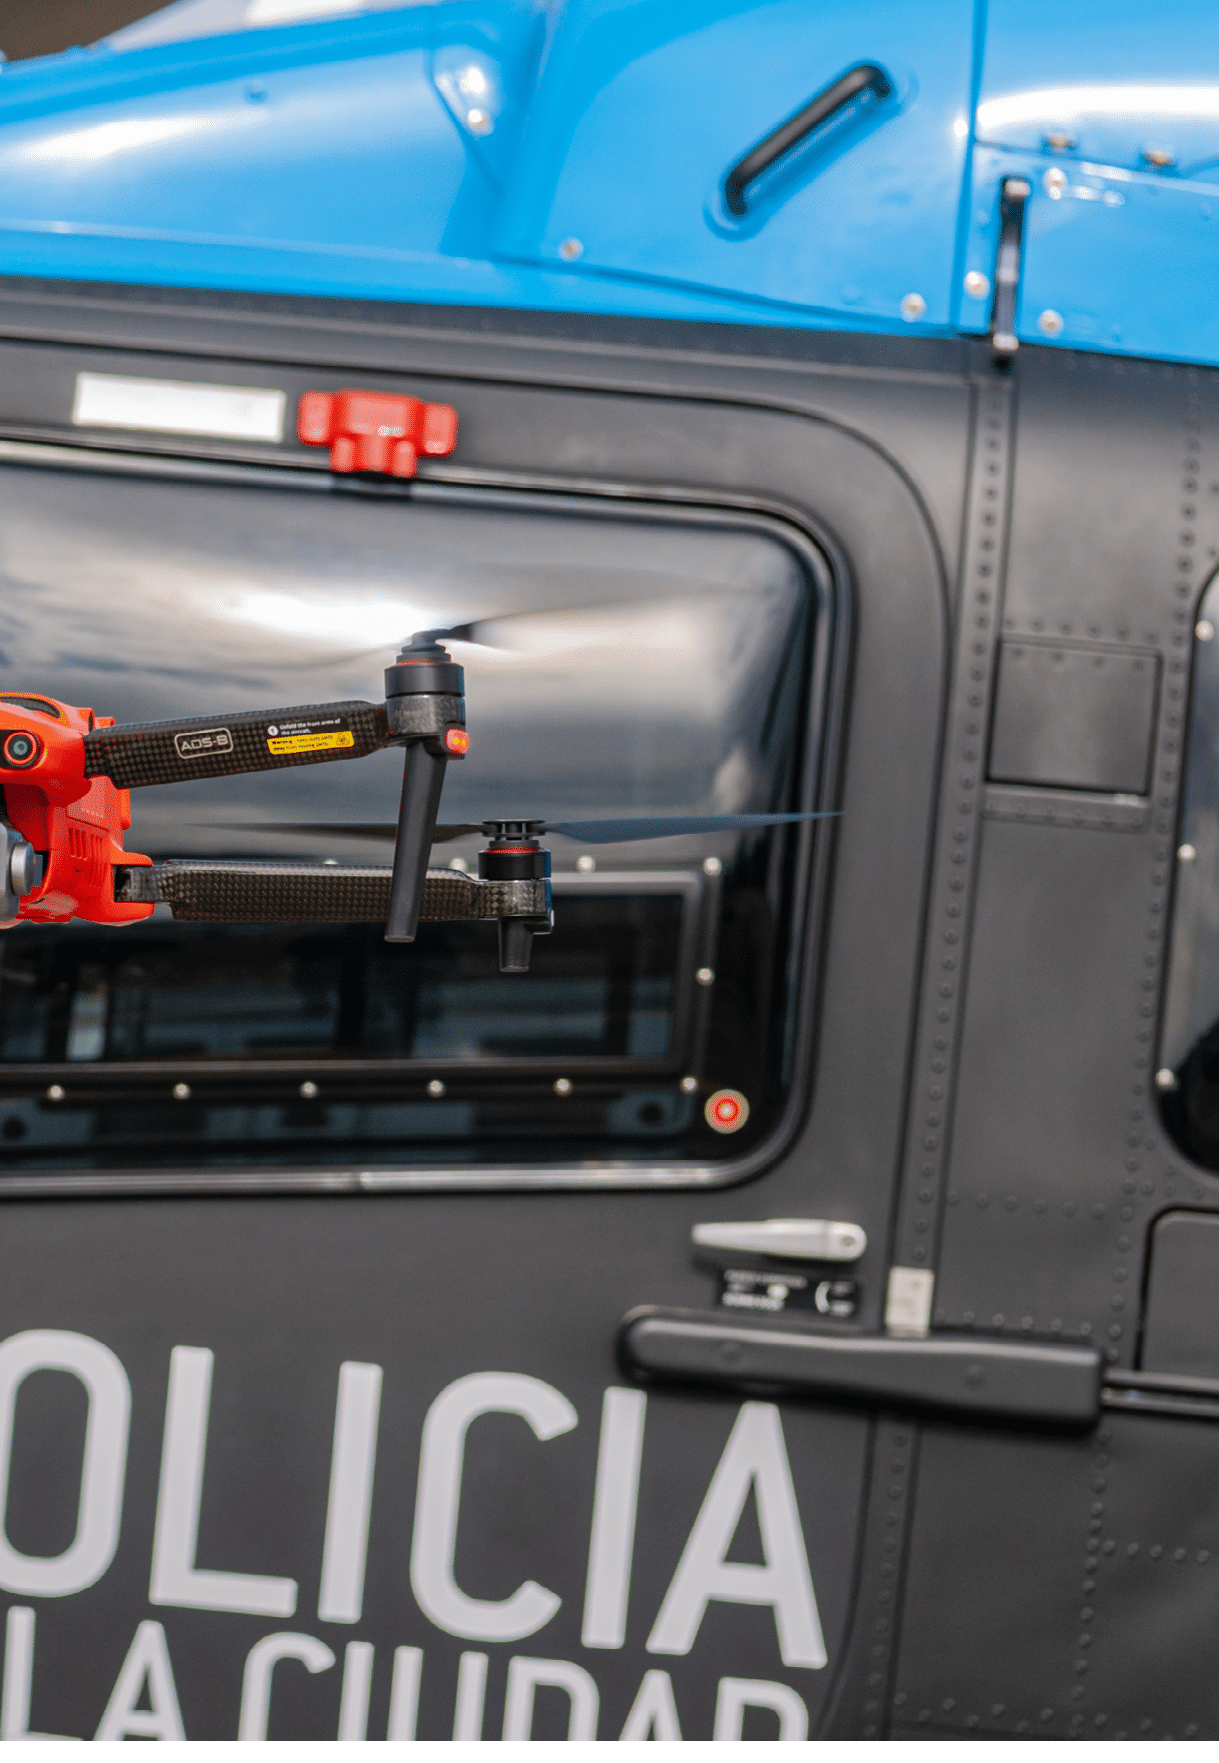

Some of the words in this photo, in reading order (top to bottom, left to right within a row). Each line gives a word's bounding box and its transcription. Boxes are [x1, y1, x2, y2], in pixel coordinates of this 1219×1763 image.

[279, 722, 297, 730] Unfold
[181, 734, 228, 751] ADS-B
[0, 1606, 187, 1741] LA
